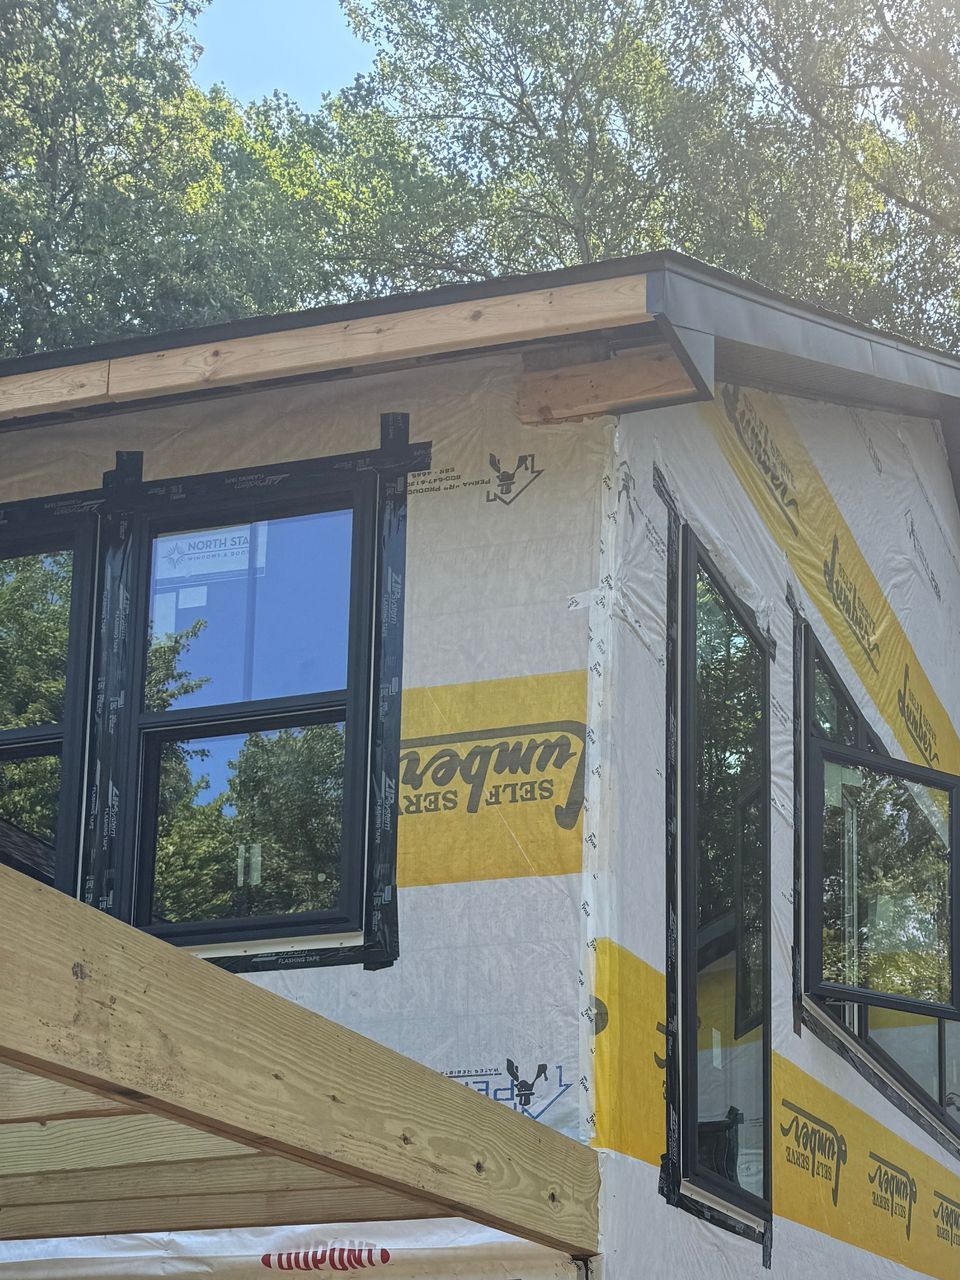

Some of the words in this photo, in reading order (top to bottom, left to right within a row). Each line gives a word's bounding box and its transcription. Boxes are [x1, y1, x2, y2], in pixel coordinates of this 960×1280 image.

[462, 478, 491, 488] PERMA
[187, 536, 228, 551] NORTH
[230, 536, 249, 547] STA
[399, 720, 588, 831] Lumber
[399, 789, 458, 816] SER
[485, 779, 554, 806] SELF
[780, 1098, 848, 1208] Lumber
[785, 1145, 810, 1172] SERVE
[816, 1159, 832, 1182] SELF
[868, 1151, 918, 1242] Lumber
[278, 1239, 381, 1272] DUPONT
